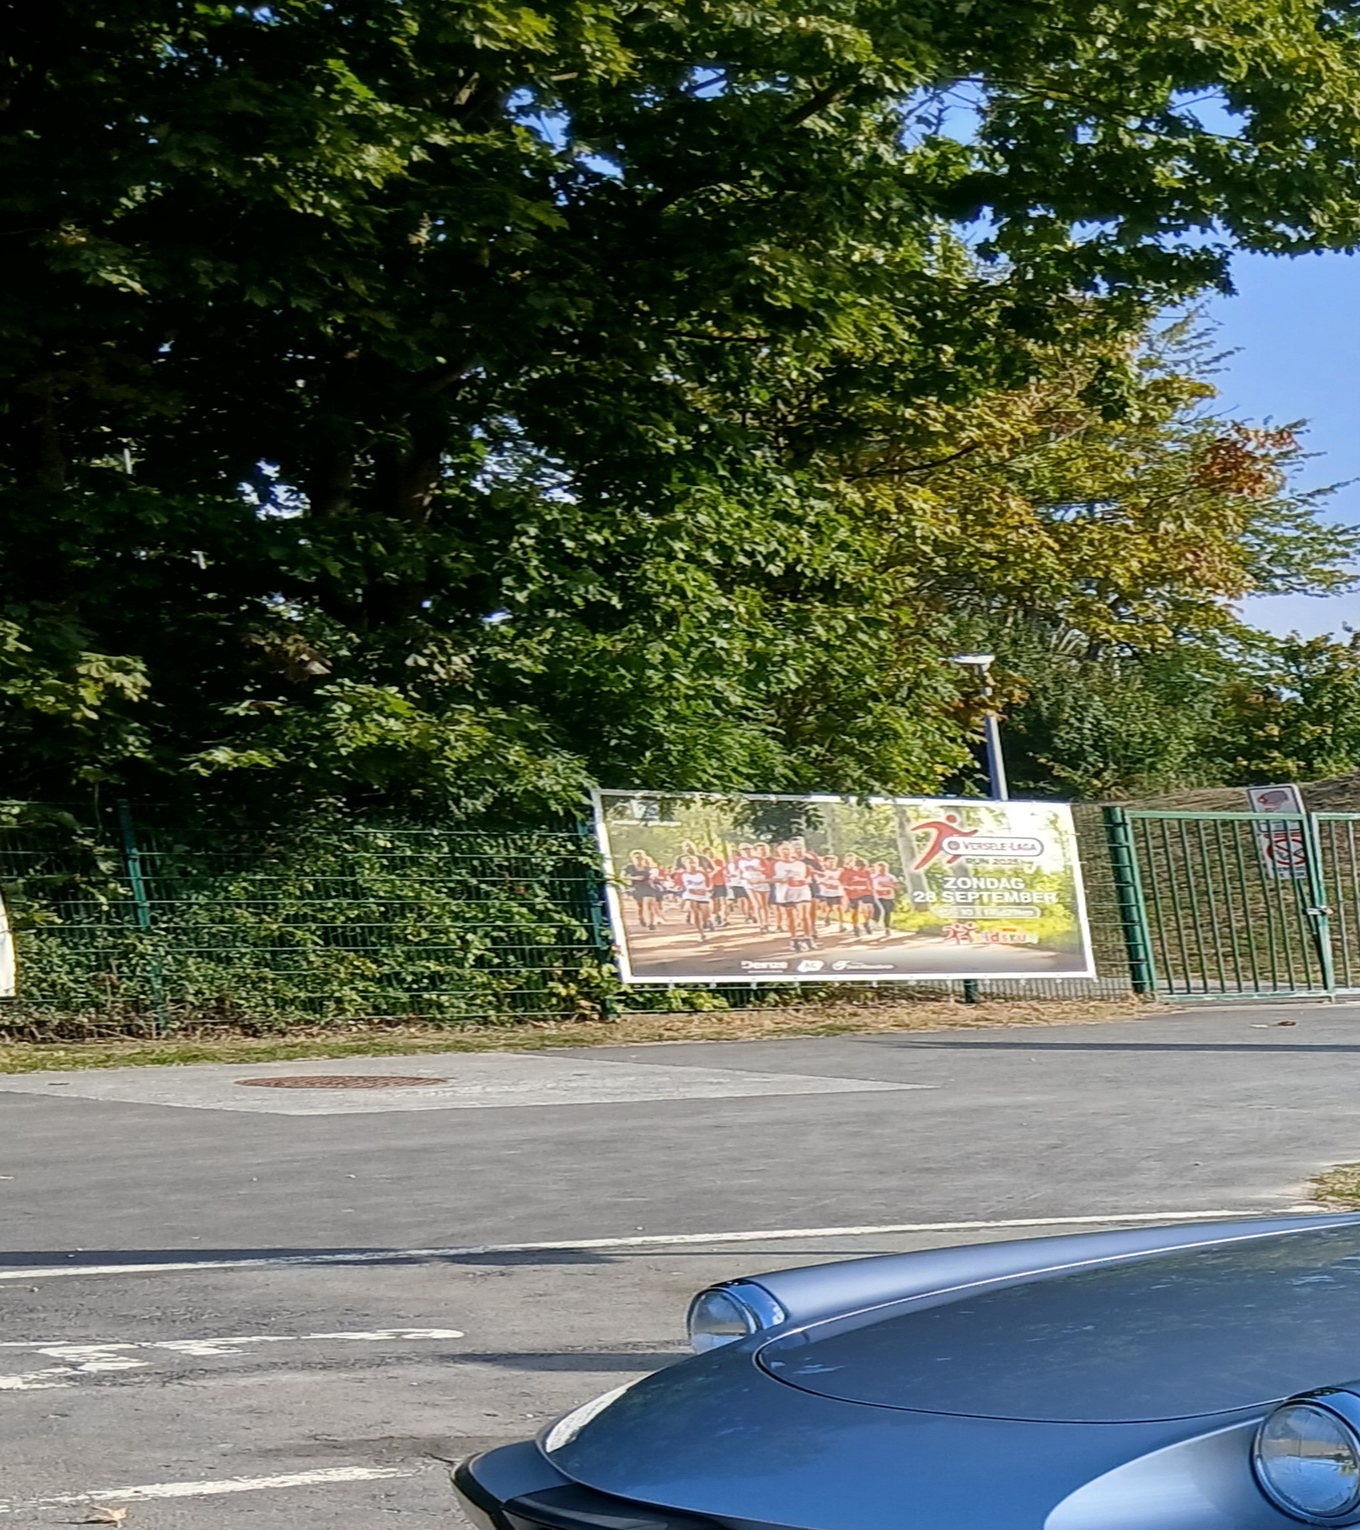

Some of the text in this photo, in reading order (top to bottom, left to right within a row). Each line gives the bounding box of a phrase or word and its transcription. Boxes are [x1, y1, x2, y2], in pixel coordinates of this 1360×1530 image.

[943, 877, 1026, 890] ZONDAG
[913, 891, 1059, 904] 28 SEPTEMBER
